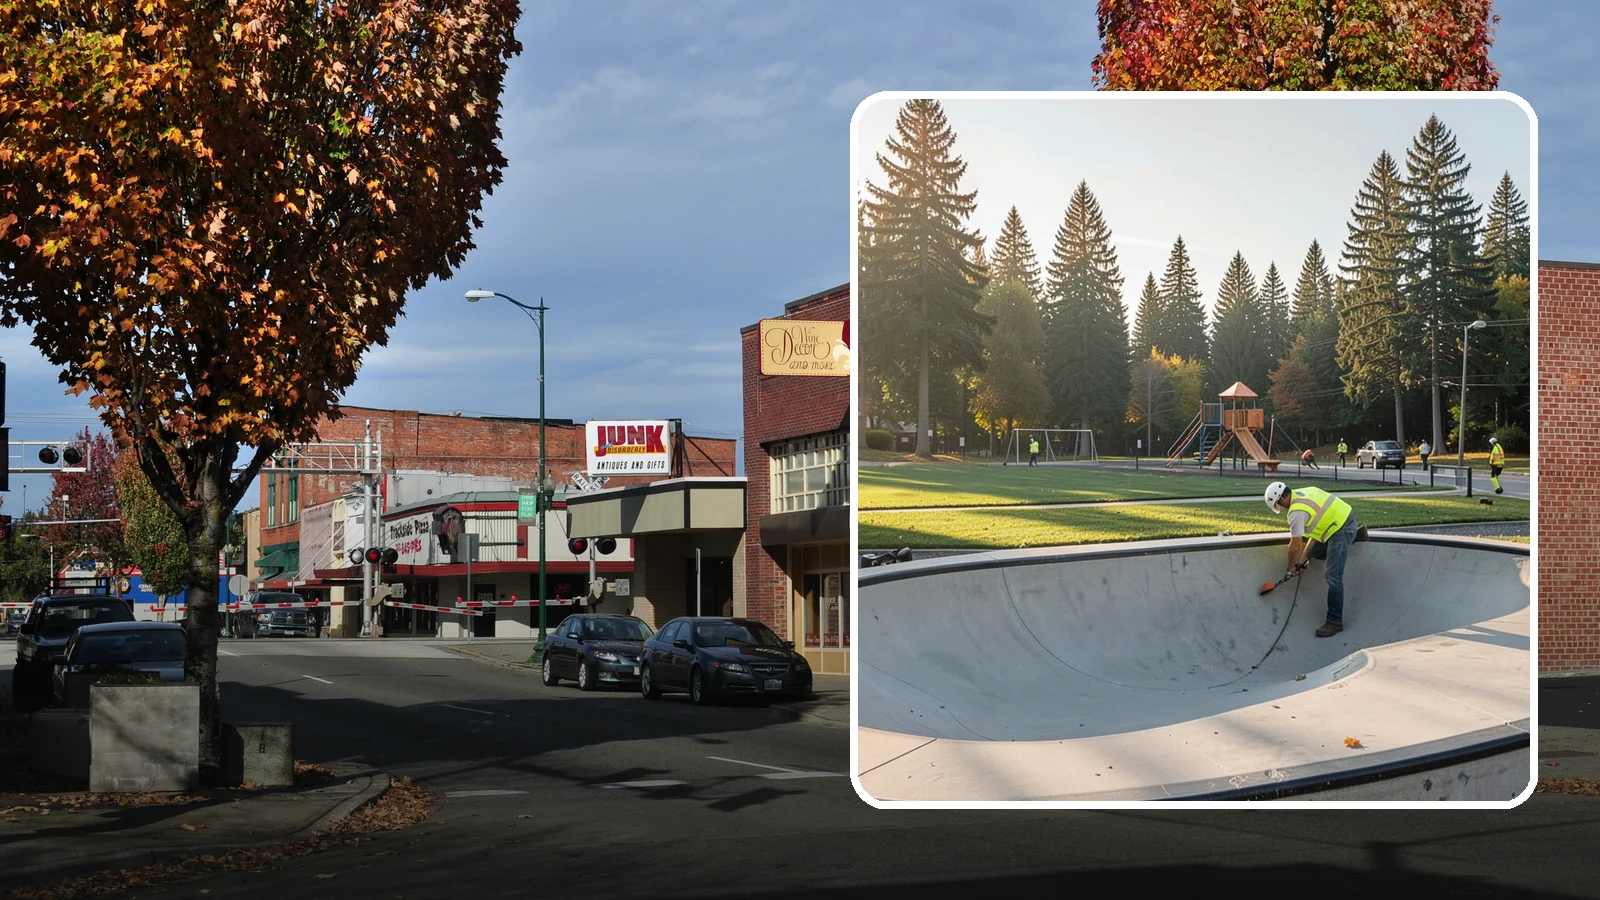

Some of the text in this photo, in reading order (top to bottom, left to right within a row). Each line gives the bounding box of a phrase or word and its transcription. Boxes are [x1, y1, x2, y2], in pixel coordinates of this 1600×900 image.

[764, 327, 831, 366] Decor
[595, 425, 664, 458] JUNK
[607, 446, 646, 454] DISORDERLY
[596, 460, 665, 470] ANTIQUES AND GIFTS
[573, 473, 588, 491] RAIL
[590, 476, 608, 491] SING
[353, 498, 364, 511] CRO
[390, 519, 429, 539] Trackside Pizza
